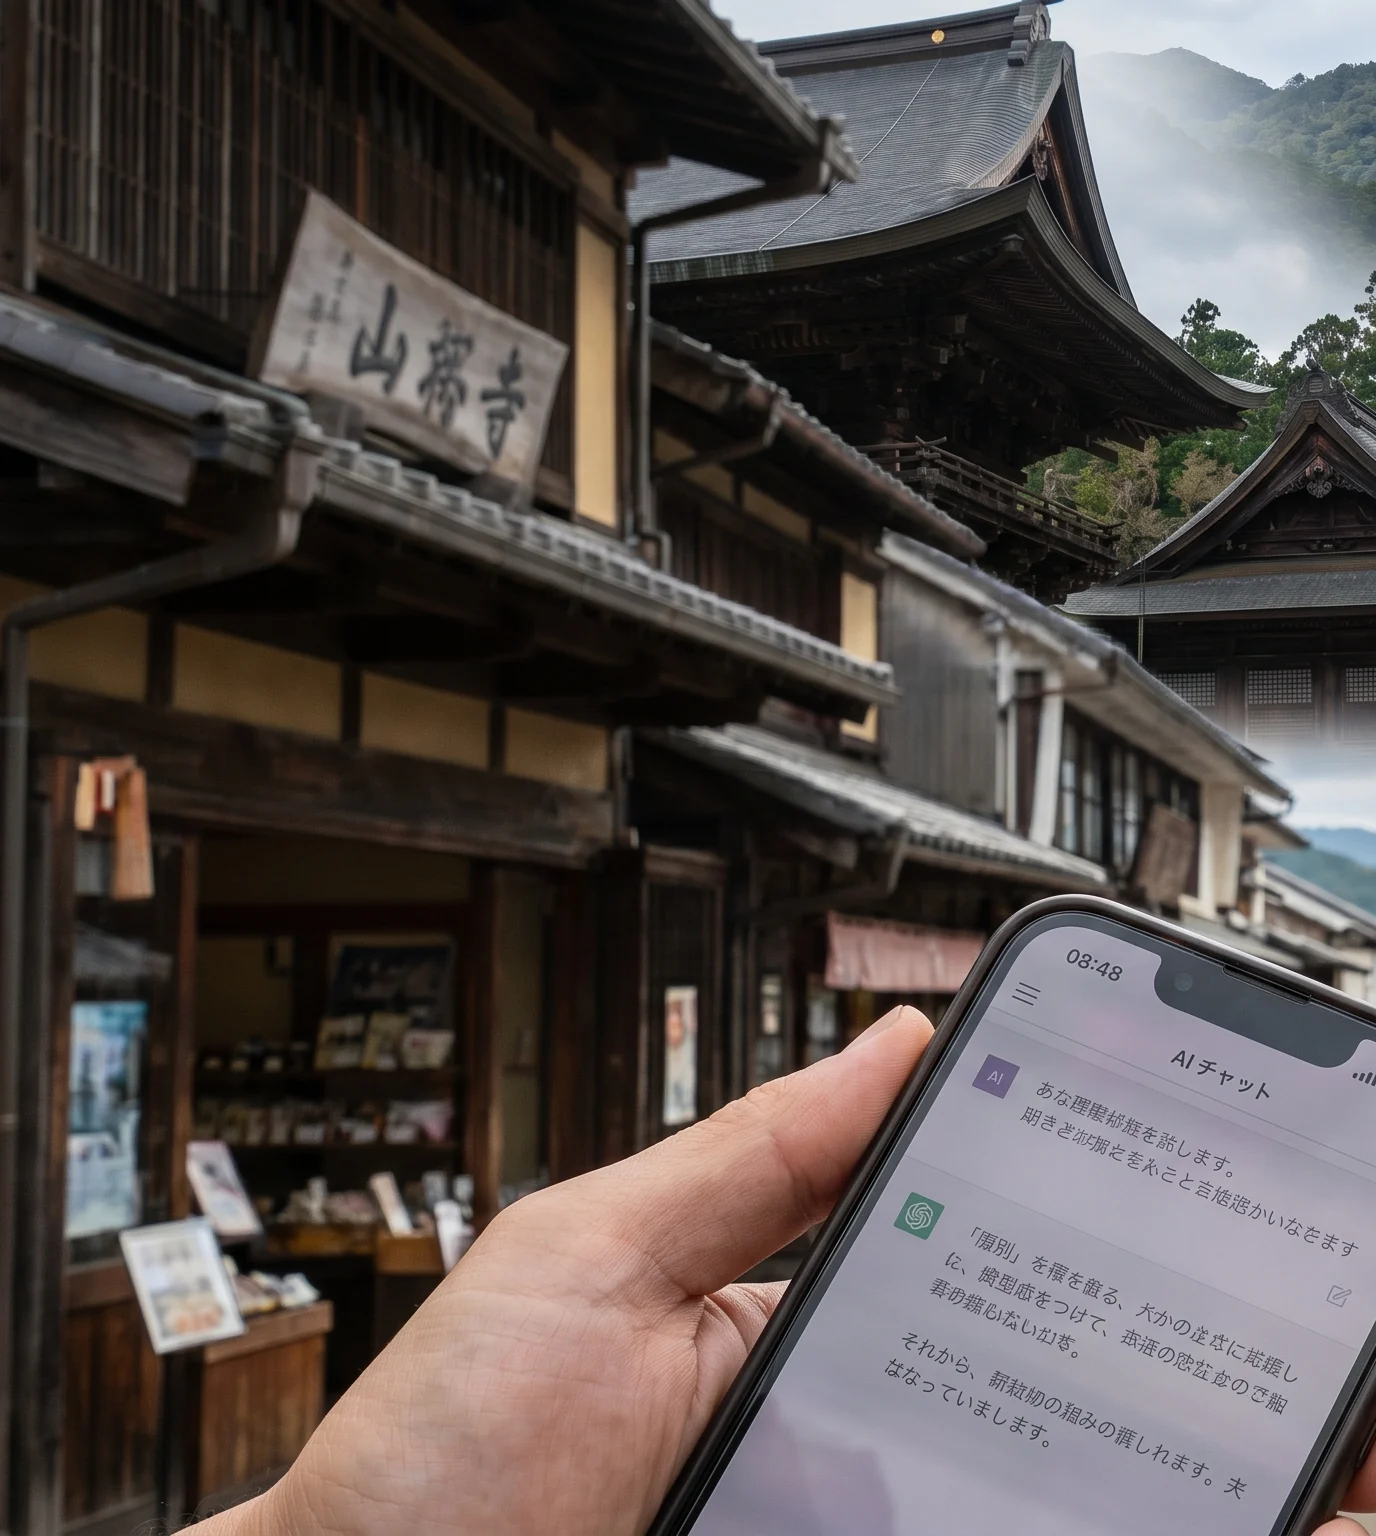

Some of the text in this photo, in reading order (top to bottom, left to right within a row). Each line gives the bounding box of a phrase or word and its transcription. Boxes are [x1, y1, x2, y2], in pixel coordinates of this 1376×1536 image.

[1066, 948, 1124, 982] 08:48
[986, 1070, 1004, 1085] AI
[1171, 1049, 1271, 1100] AI チャット
